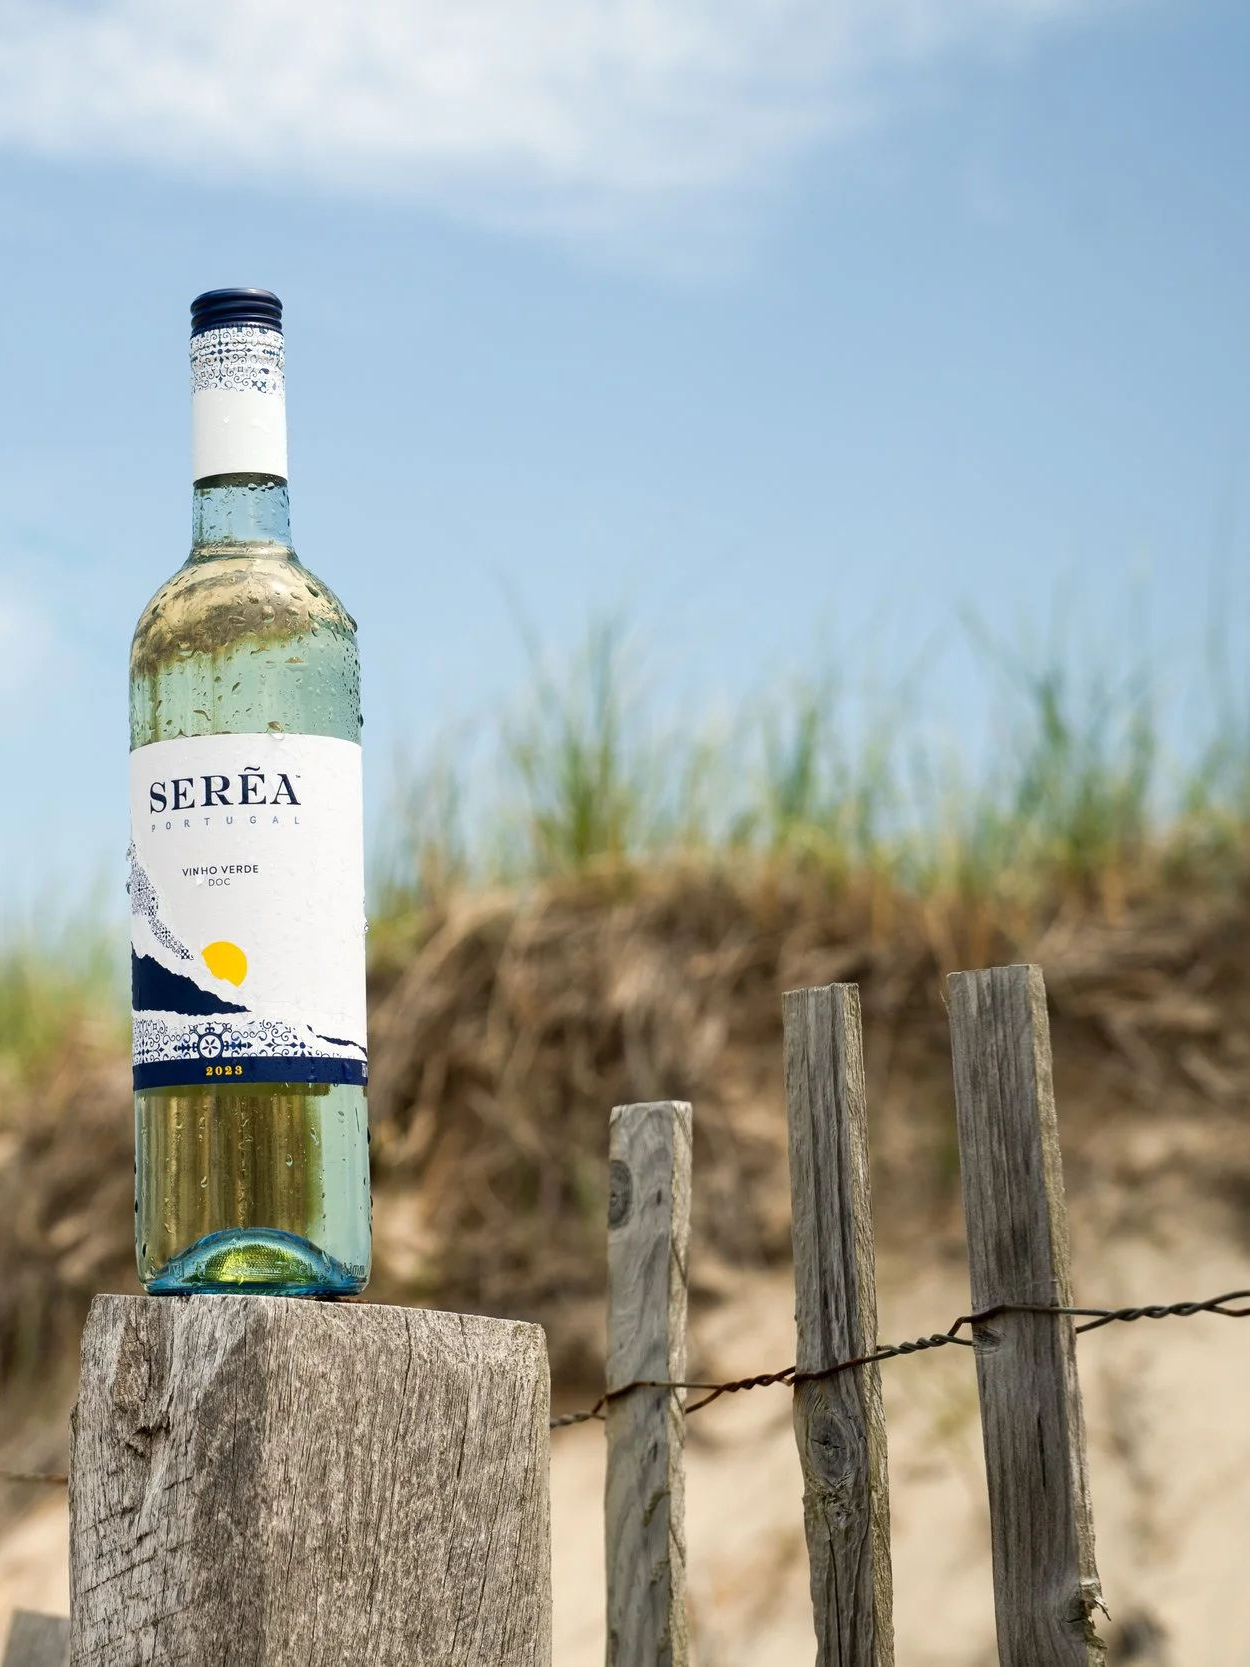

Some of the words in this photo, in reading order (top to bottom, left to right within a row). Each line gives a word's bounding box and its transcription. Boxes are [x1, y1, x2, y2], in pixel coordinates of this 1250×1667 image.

[151, 815, 300, 832] PORTUGAL
[182, 866, 218, 876] VINHO
[221, 865, 259, 874] VERDE
[208, 878, 231, 887] DOC
[205, 1065, 243, 1076] 2023
